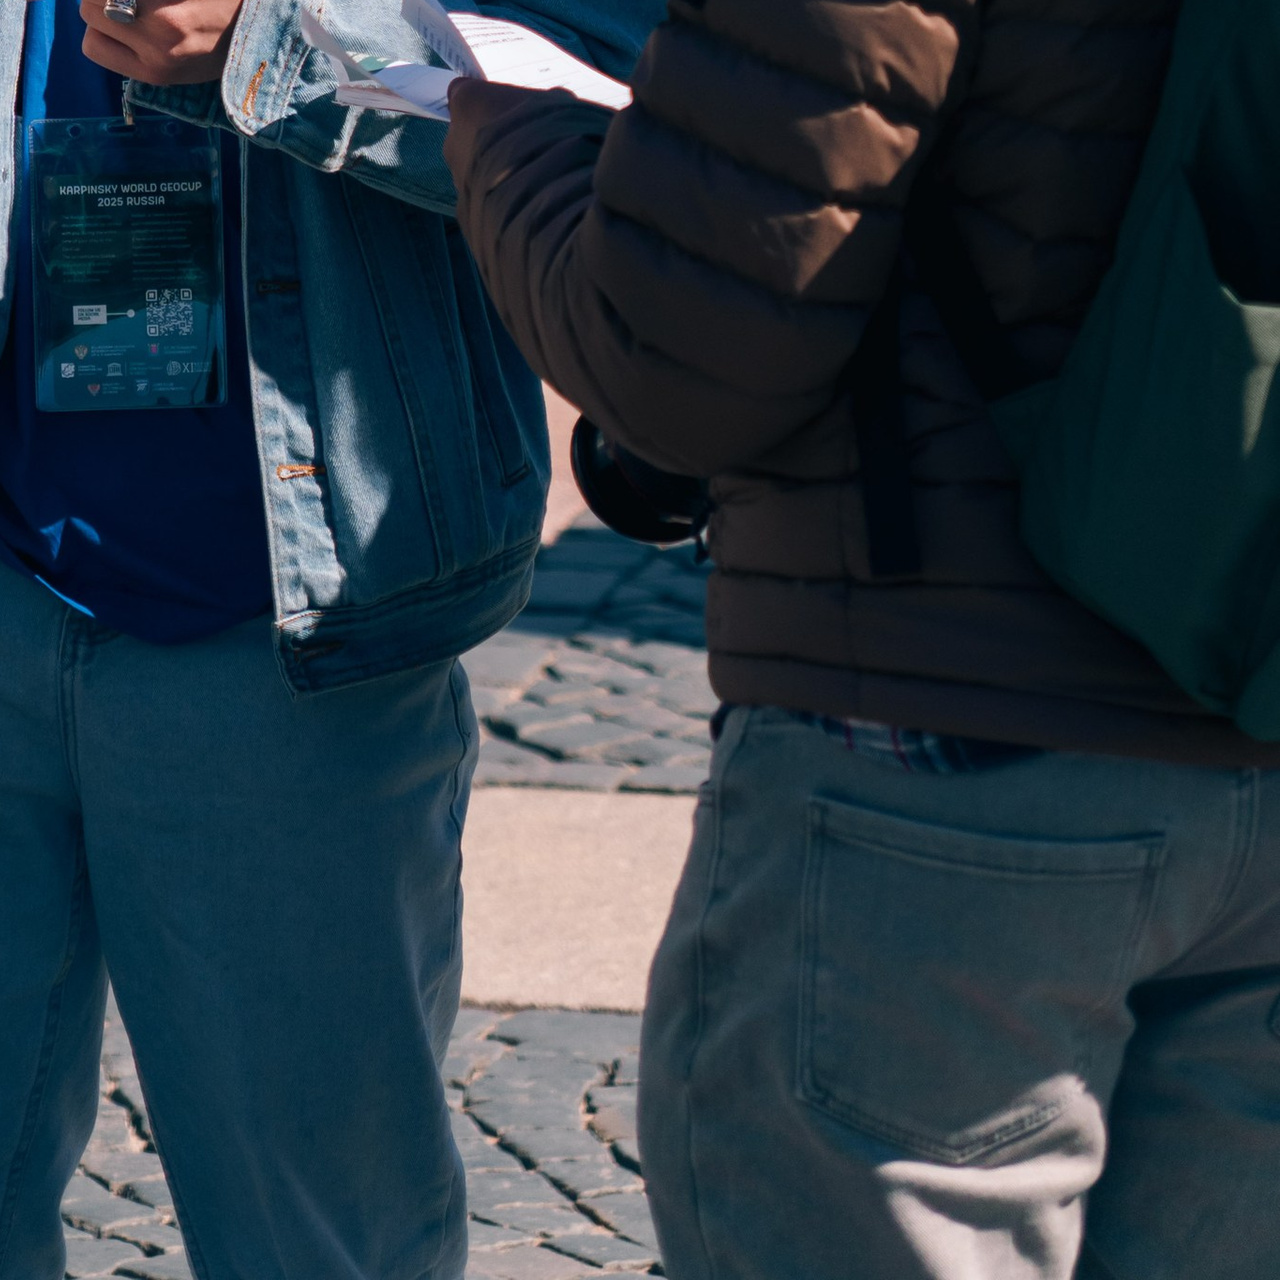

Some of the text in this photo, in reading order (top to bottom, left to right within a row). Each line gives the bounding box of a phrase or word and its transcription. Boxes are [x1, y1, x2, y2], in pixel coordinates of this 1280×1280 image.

[59, 181, 202, 196] KARPINSKY WORLD GEOCUP
[97, 195, 165, 207] 2025 RUSSIA
